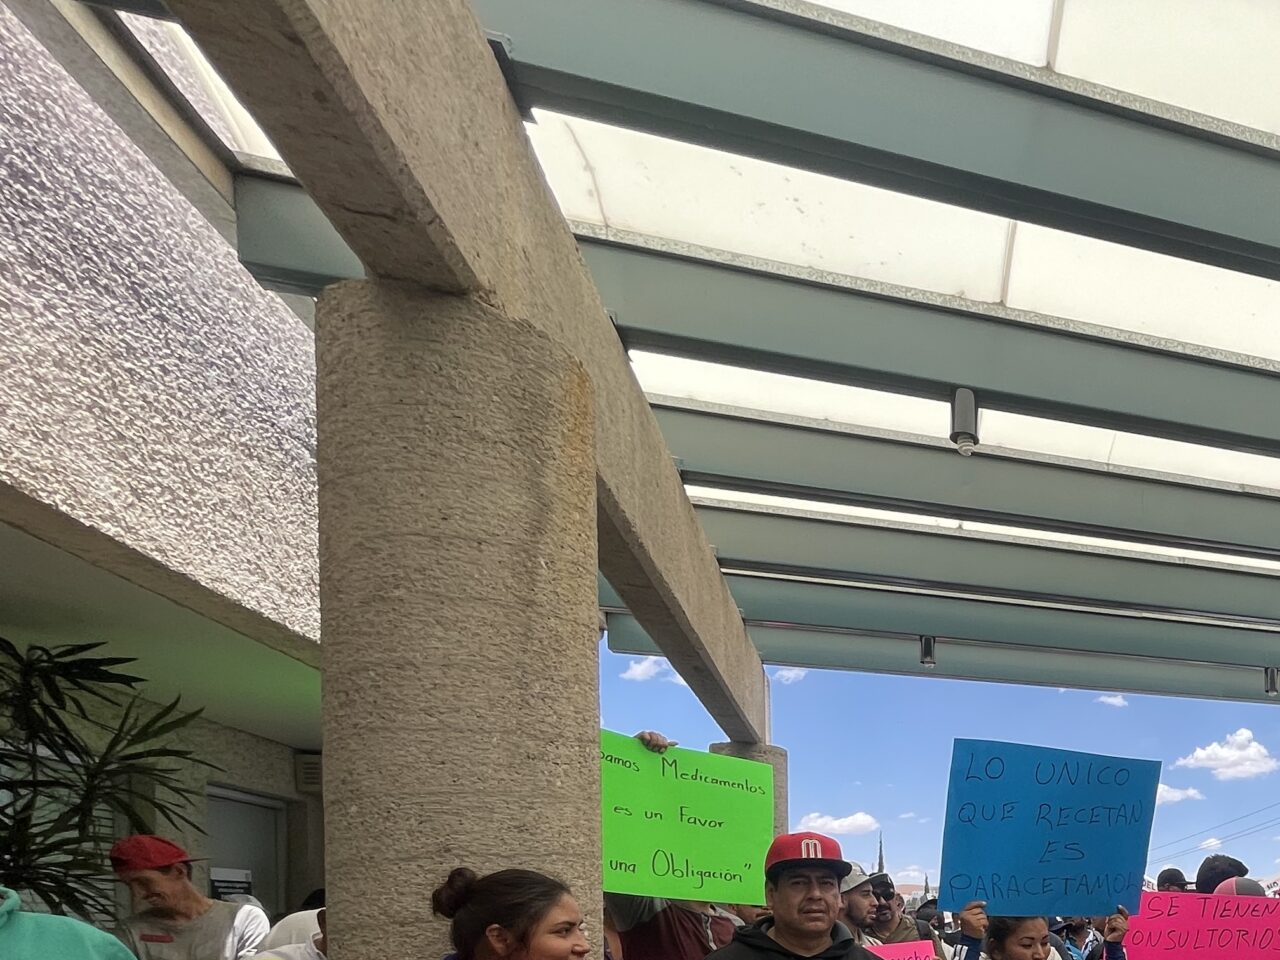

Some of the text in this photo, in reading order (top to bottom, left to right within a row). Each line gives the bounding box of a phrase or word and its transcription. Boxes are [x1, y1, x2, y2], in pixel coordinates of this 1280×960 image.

[966, 752, 1130, 786] LO UNICO
[613, 805, 725, 829] es un Favor
[958, 800, 1143, 831] QUE RECETAN
[1038, 839, 1086, 864] ES
[950, 872, 1143, 901] PARACETAMOL
[1146, 895, 1280, 920] SE TIENEN
